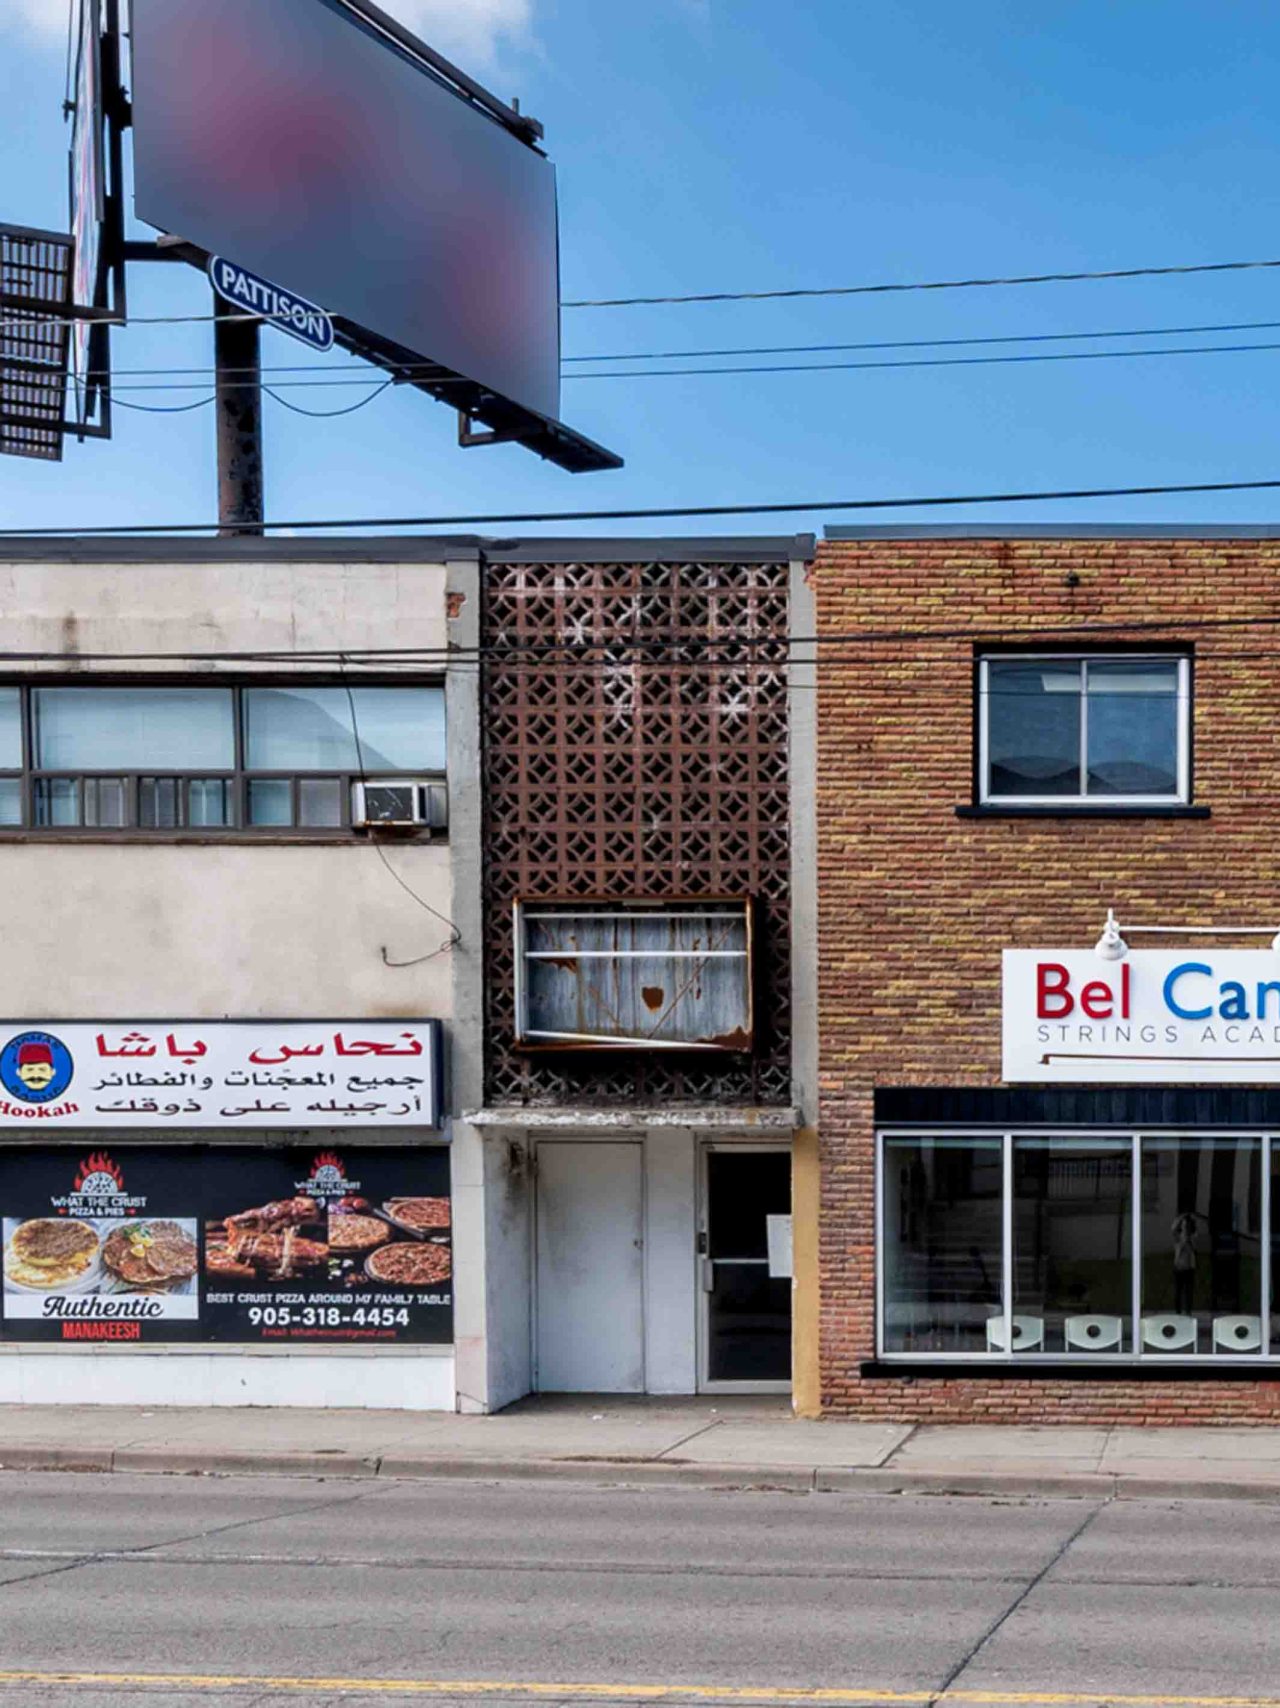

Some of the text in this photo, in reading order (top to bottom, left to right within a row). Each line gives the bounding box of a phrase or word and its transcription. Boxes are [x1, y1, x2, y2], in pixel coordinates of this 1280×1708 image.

[221, 262, 325, 342] PATTISON
[1036, 962, 1131, 1020] Bel
[1037, 1025, 1178, 1043] STRINGS
[96, 1032, 208, 1065] باشا
[248, 1032, 424, 1064] نحاس
[51, 1197, 147, 1206] WHAT THE CRUST
[69, 1208, 95, 1216] PIZZA
[104, 1208, 125, 1216] PIES
[42, 1296, 164, 1317] Authentic
[206, 1294, 234, 1303] BEST
[237, 1294, 273, 1303] CRUST
[275, 1294, 305, 1304] PIZZA
[308, 1294, 353, 1304] AROUND
[374, 1294, 413, 1304] FAMILY
[416, 1294, 451, 1304] TABLE
[249, 1307, 409, 1326] 905-318-4454
[62, 1322, 140, 1339] MANAKEESH
